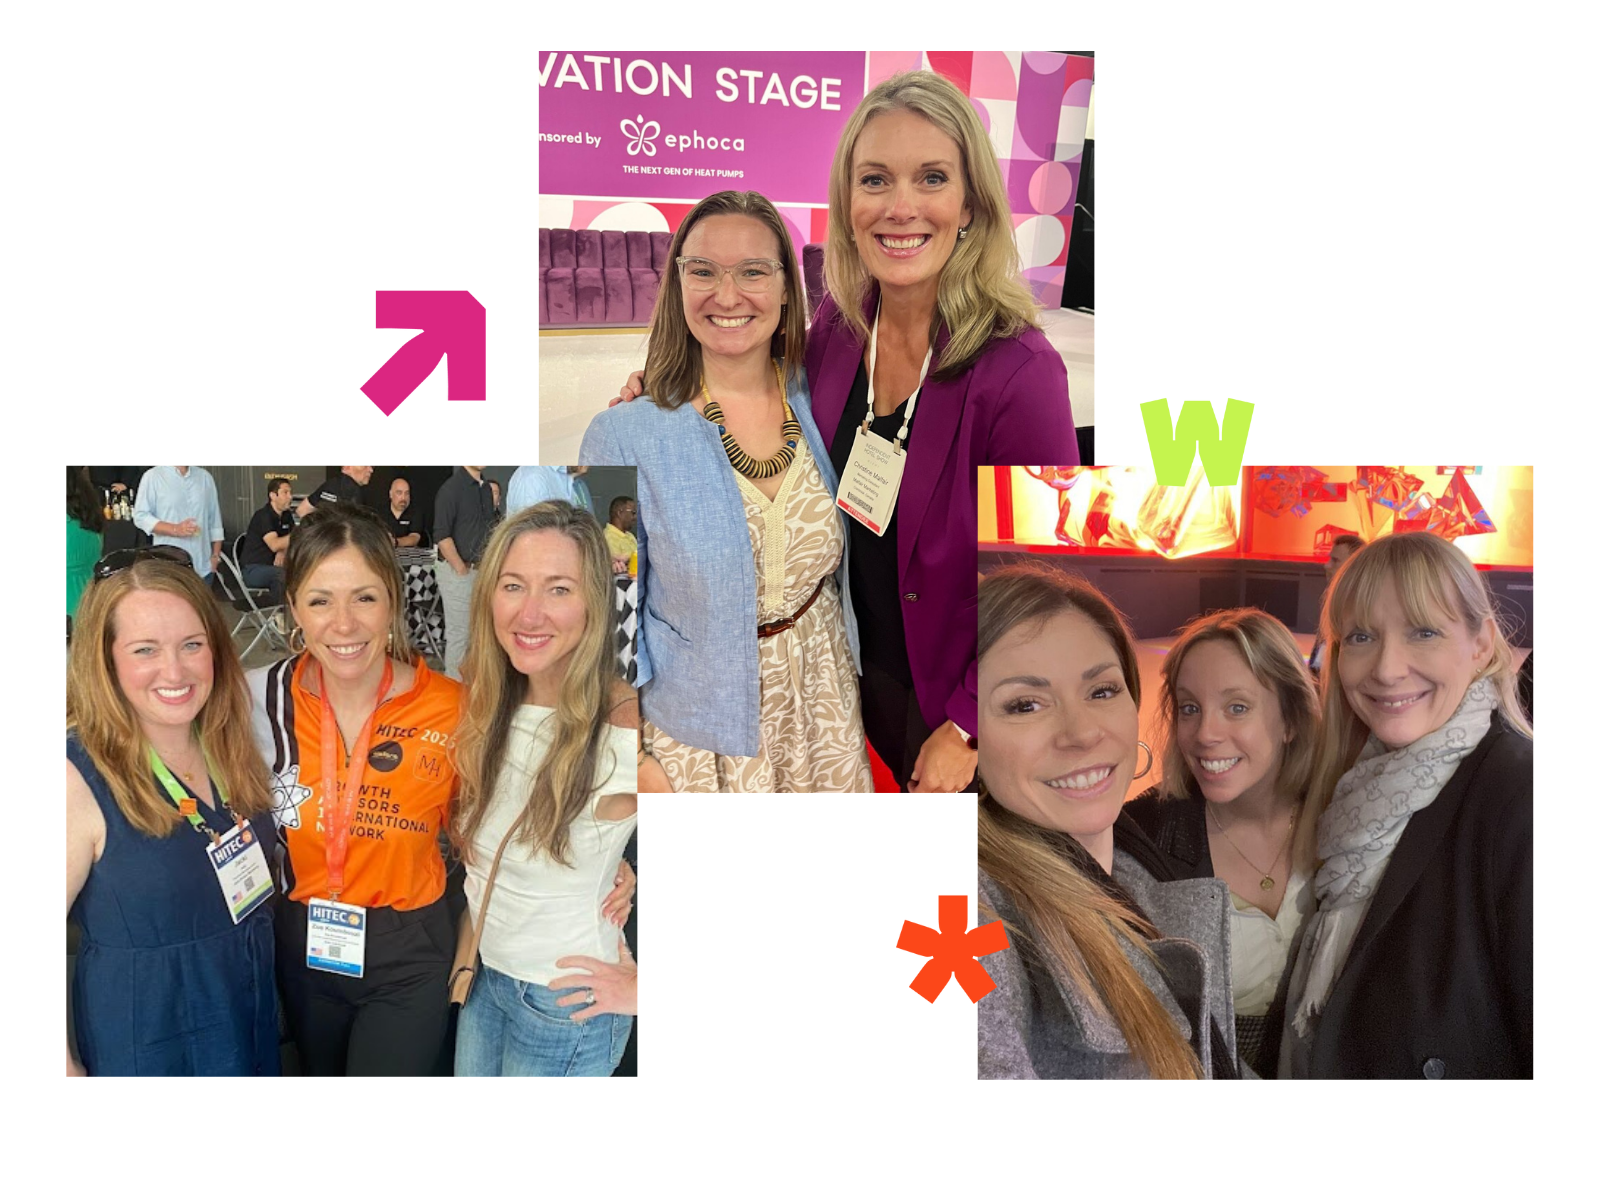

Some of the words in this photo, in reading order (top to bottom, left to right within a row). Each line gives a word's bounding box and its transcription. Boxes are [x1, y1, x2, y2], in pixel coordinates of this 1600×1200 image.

[715, 67, 842, 111] STAGE
[586, 132, 602, 148] by
[665, 129, 745, 152] ephoca
[622, 165, 639, 174] THE
[640, 166, 662, 175] NEXT
[663, 167, 681, 175] GEN
[682, 168, 693, 176] OF
[694, 169, 716, 177] HEAT
[717, 170, 744, 178] PUMPS
[853, 460, 873, 477] Christine
[376, 724, 418, 739] HITEC
[213, 836, 244, 864] HITEC
[312, 906, 348, 923] HITEC
